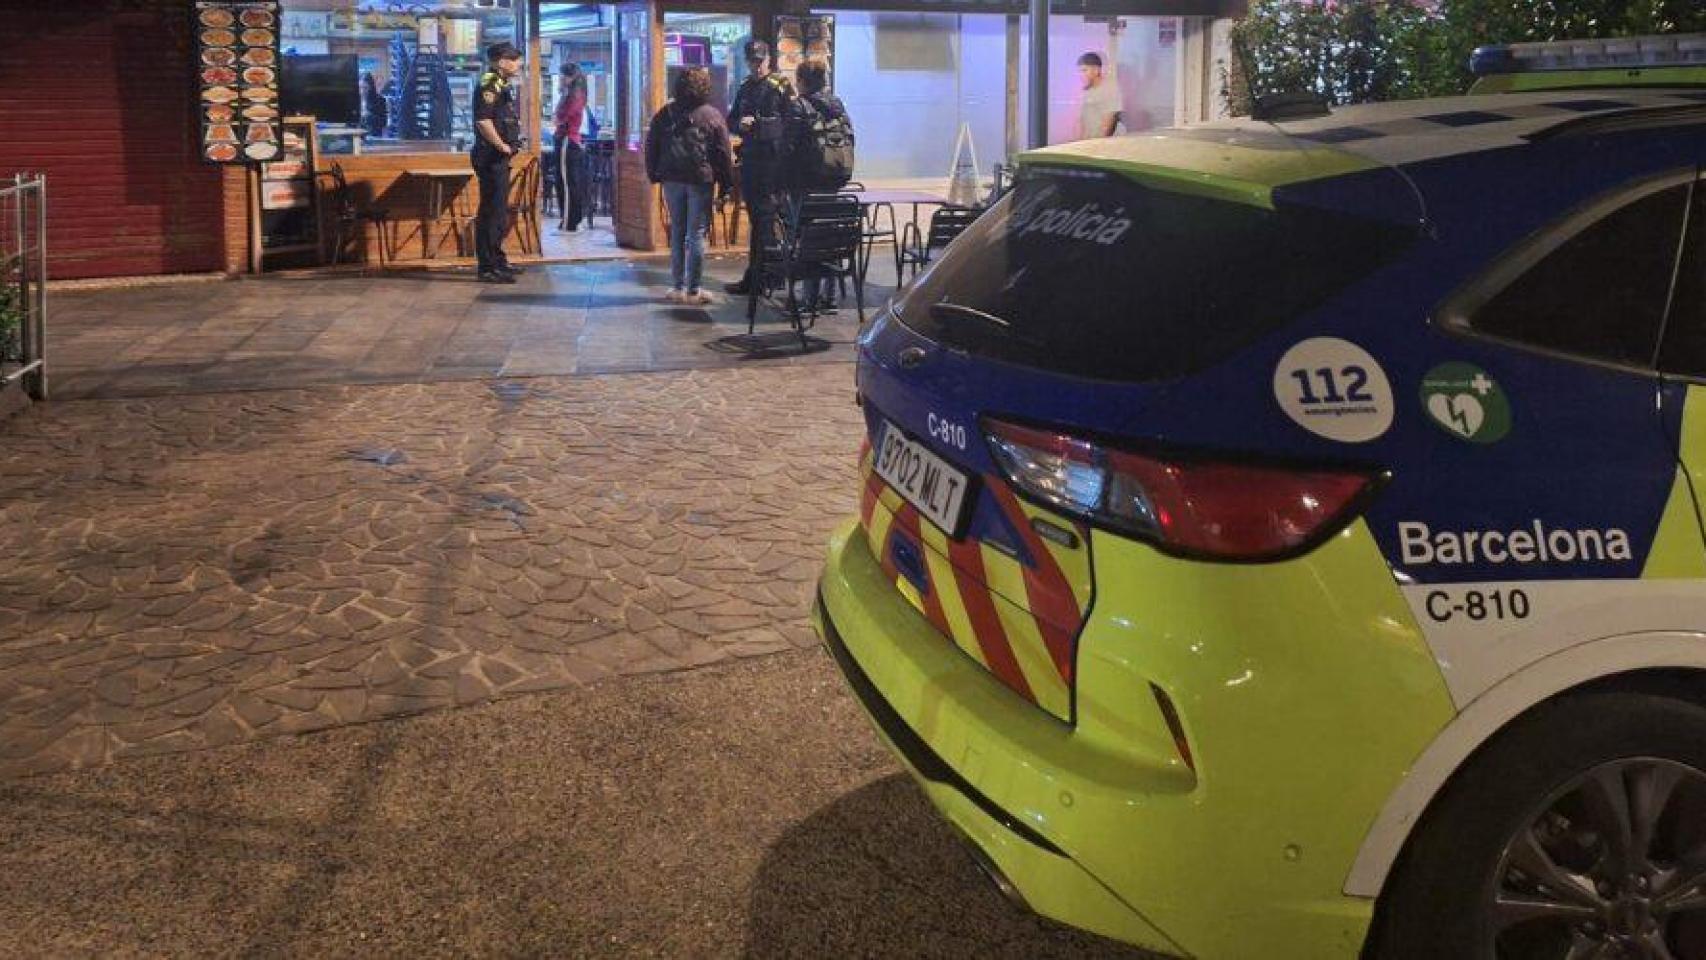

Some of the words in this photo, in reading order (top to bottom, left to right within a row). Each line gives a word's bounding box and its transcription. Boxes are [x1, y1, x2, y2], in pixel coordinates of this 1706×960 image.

[1291, 366, 1373, 404] 112
[928, 412, 966, 450] C-810
[881, 433, 921, 493] 9702
[919, 459, 958, 518] MLT
[1398, 519, 1632, 565] Barcelona
[1426, 588, 1530, 622] C-810
